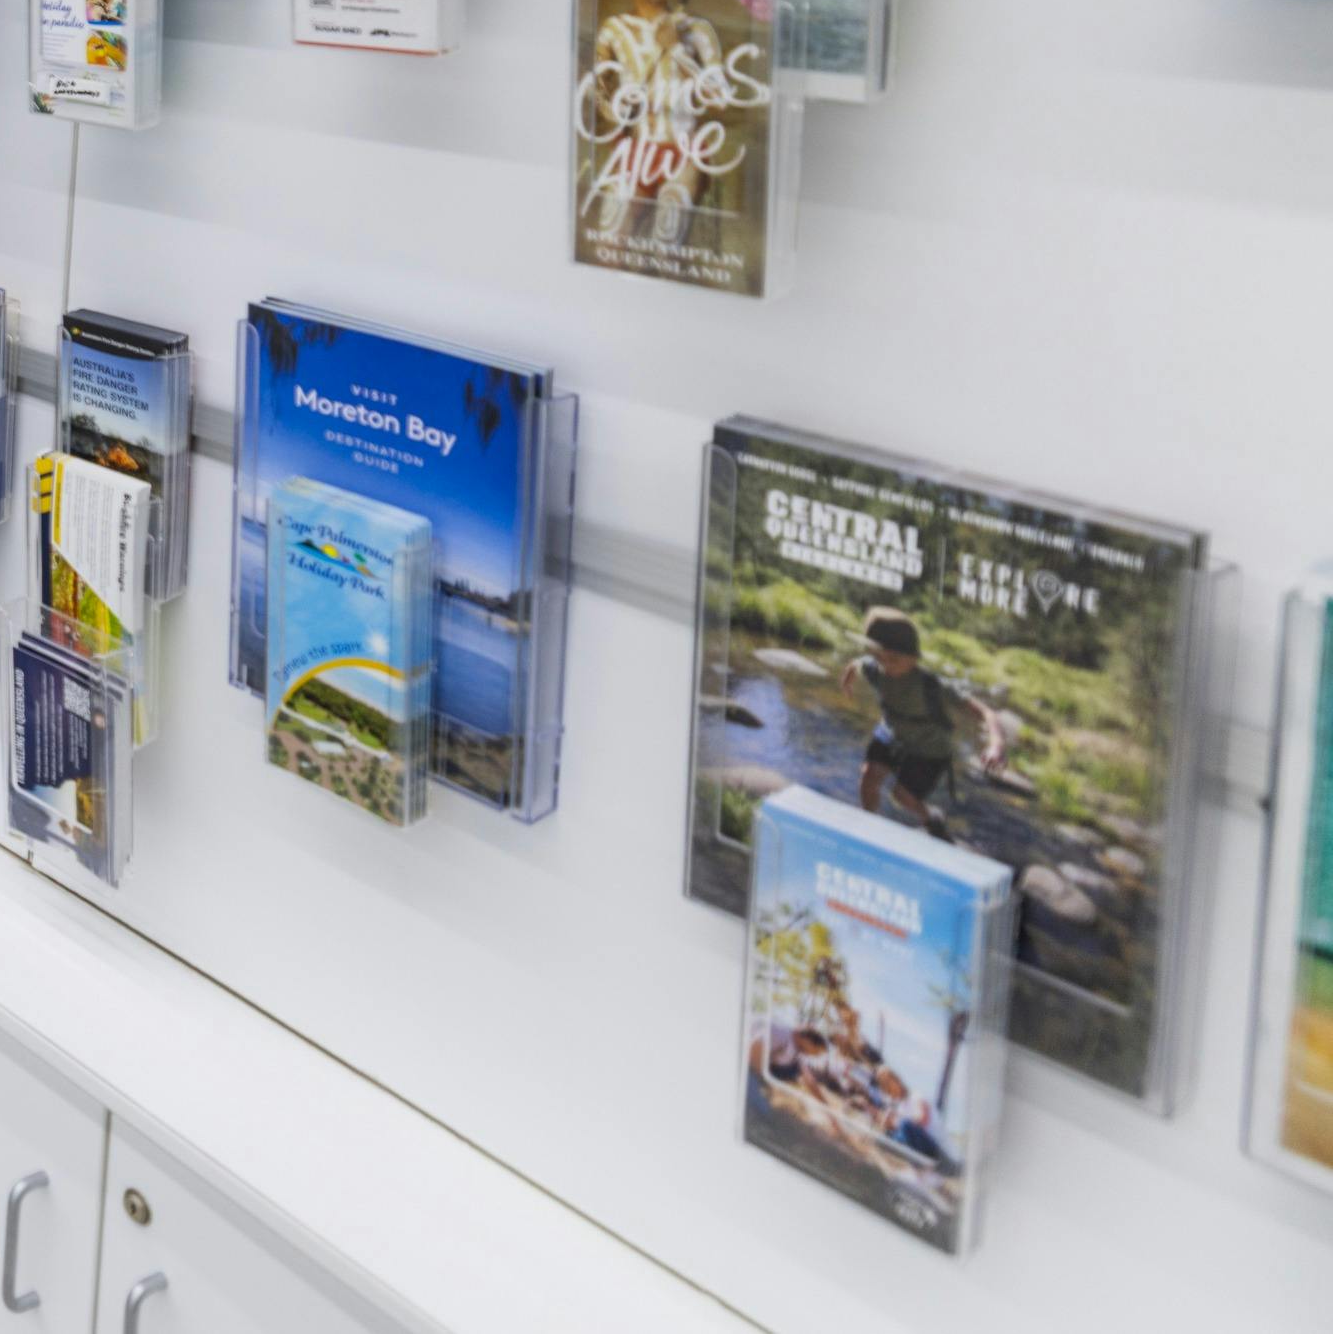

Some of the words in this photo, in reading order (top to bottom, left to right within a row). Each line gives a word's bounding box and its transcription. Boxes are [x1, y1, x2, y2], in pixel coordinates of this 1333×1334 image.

[585, 228, 745, 267] ROCKHAMPTON
[596, 245, 732, 283] QUEENSLAND
[73, 356, 136, 383] AUSTRALIA'S
[73, 368, 95, 383] FIRE
[96, 373, 138, 396] DANGER
[73, 380, 108, 399] RATING
[109, 389, 149, 412] SYSTEM
[73, 392, 82, 403] IS
[350, 384, 399, 406] VISIT
[294, 384, 401, 435] Moreton
[405, 414, 457, 457] Bay
[324, 429, 425, 468] DESTINATION
[353, 450, 400, 474] GUIDE
[278, 515, 314, 536] Cape
[316, 520, 394, 566] Palmerston
[765, 489, 923, 554] CENTRAL
[765, 515, 923, 580] QUEENSLAND
[286, 551, 347, 589] Holiday
[348, 574, 387, 601] Park
[958, 580, 1030, 618] MORE
